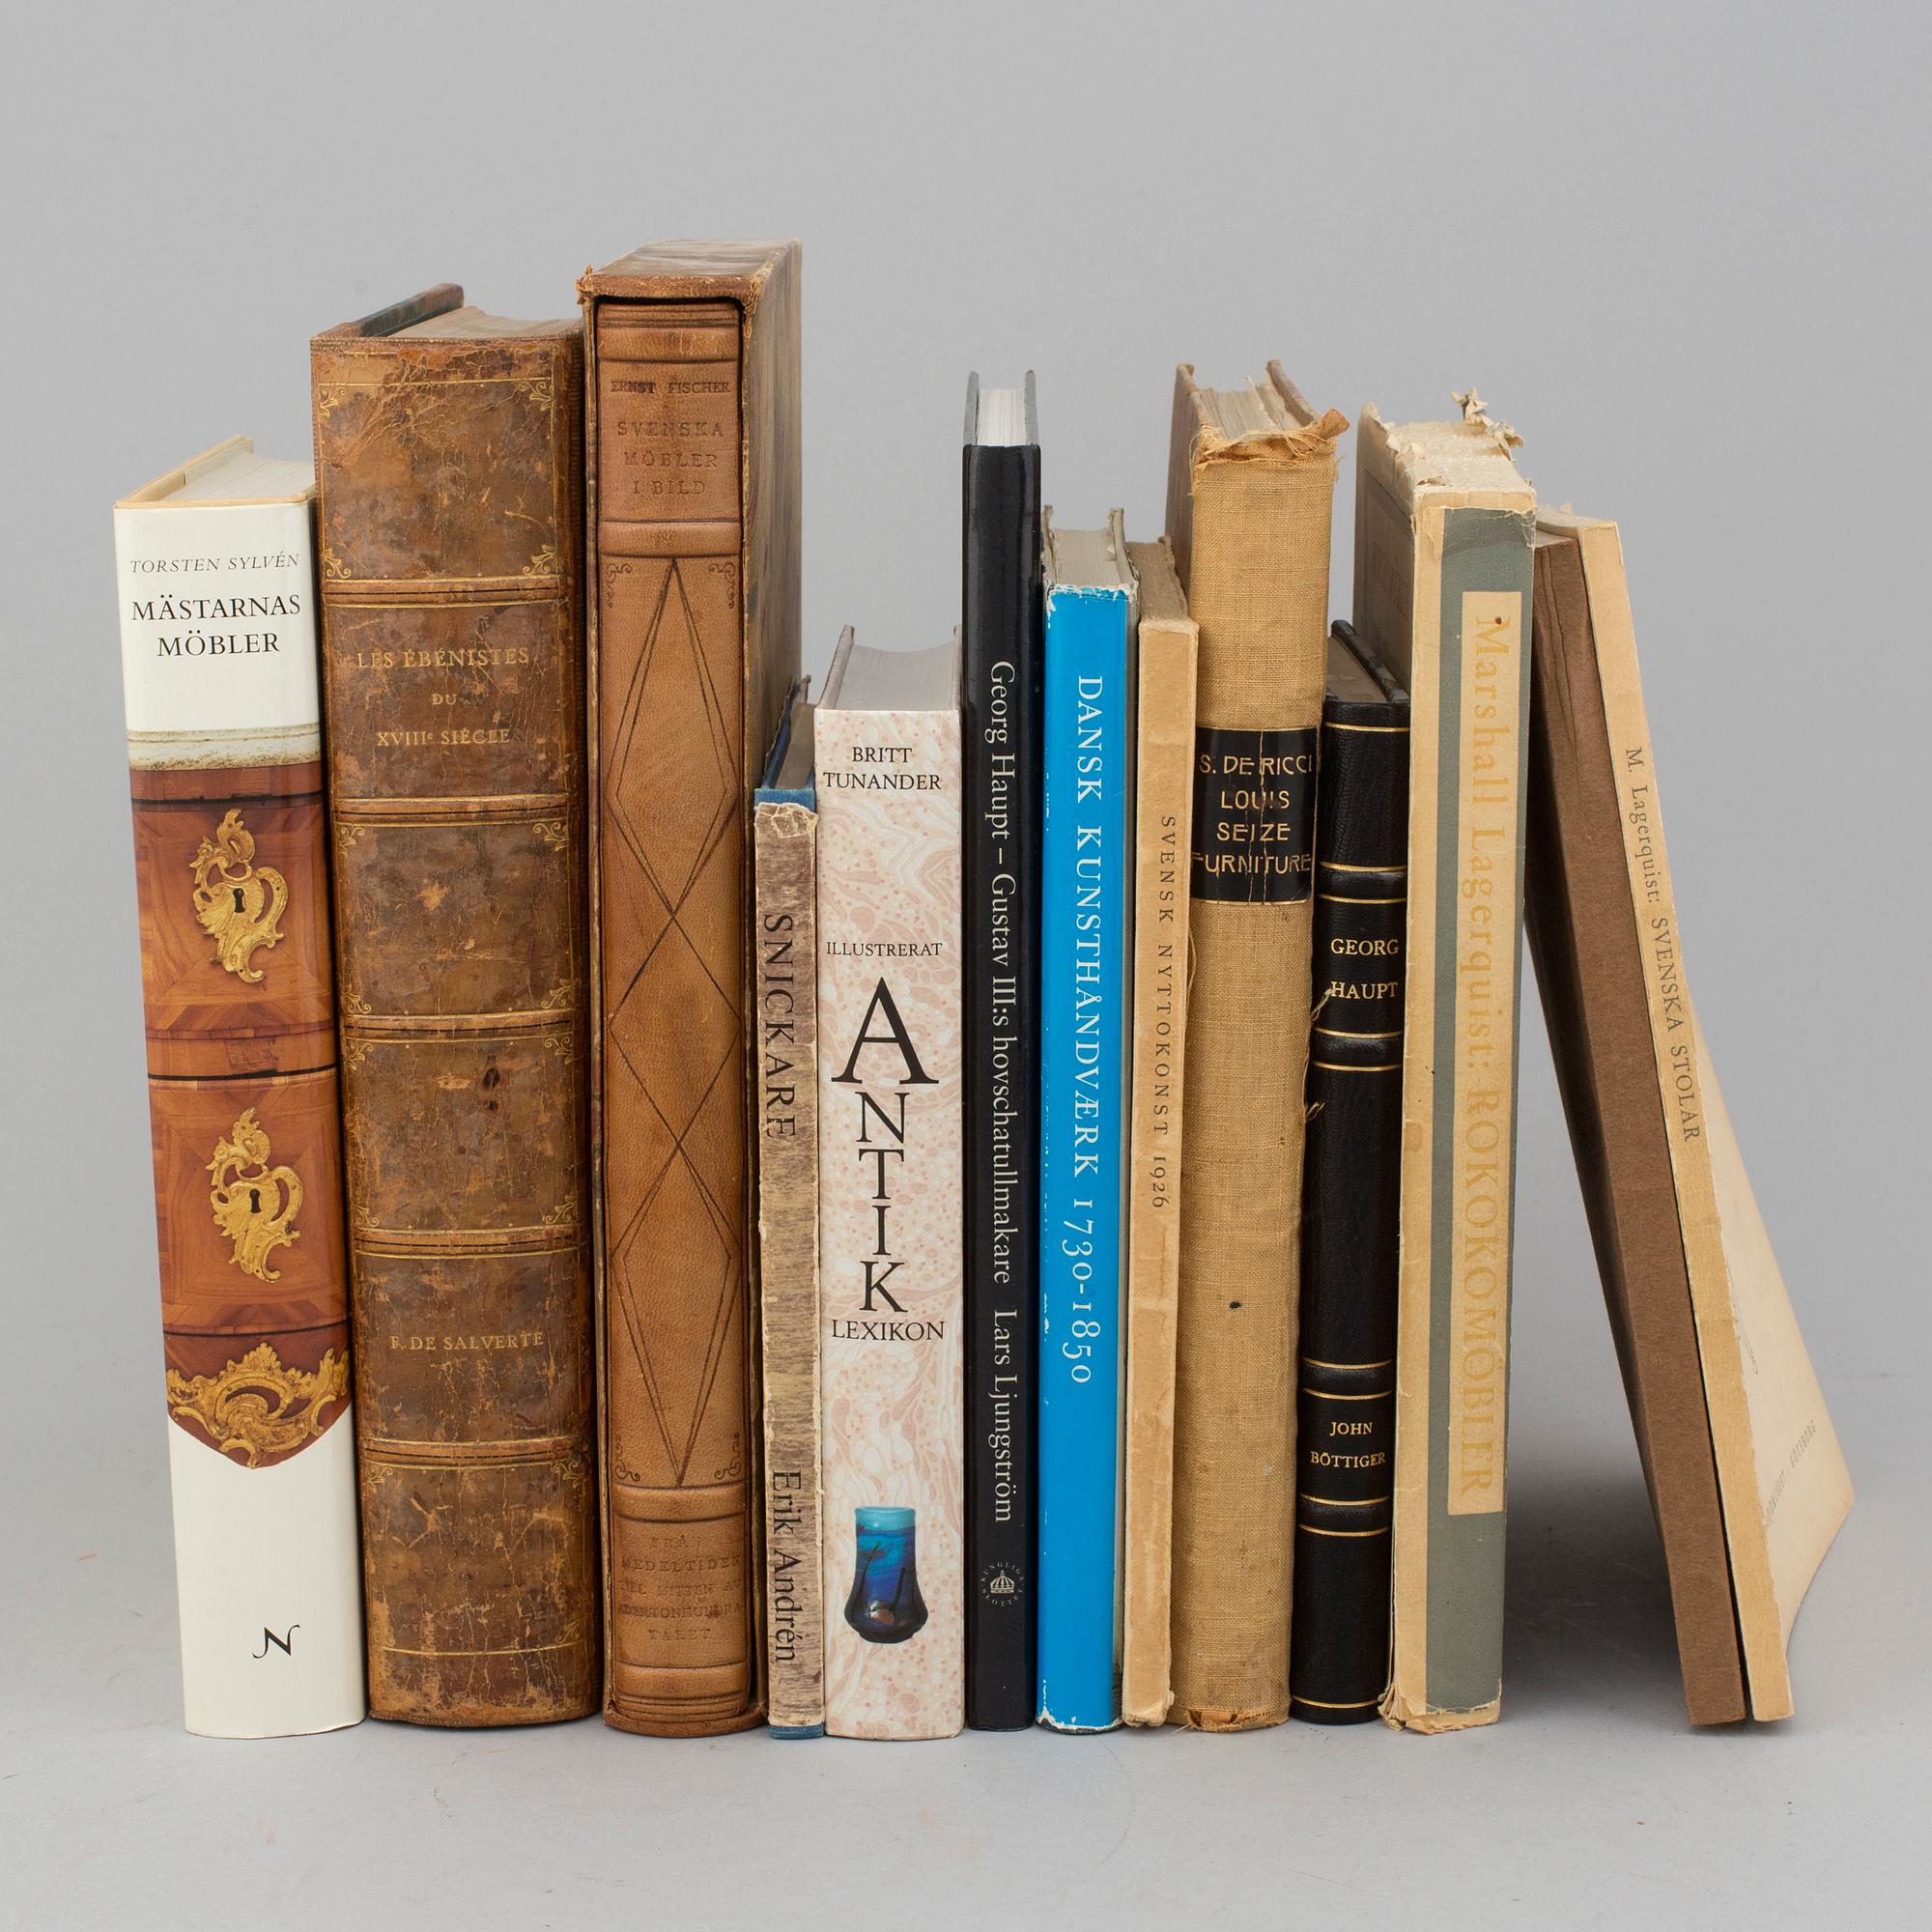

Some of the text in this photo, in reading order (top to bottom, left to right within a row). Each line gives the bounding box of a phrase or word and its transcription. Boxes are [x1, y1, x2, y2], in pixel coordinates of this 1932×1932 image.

[611, 381, 731, 394] ERNST FISCHER
[617, 421, 724, 437] SVENSKA
[624, 450, 718, 468] MÖBLER
[633, 480, 705, 495] I BILD
[130, 550, 299, 574] TORSTEN SYLVÉN
[131, 593, 301, 621] MÄSTARNAS
[156, 630, 280, 657] MÖBLER
[357, 647, 530, 668] LES ÉBÉNISTES
[431, 694, 457, 705] DU
[984, 661, 1015, 744] Georg
[440, 727, 511, 745] SIÈCLE
[852, 747, 913, 763] BRITT
[1199, 753, 1313, 776] S. DE RICCI
[823, 772, 942, 790] TUNANDER
[984, 753, 1016, 839] Haupt
[1221, 790, 1290, 810] LOUIS
[1216, 822, 1292, 841] SEIZE
[991, 873, 1016, 967] Gustav
[826, 942, 943, 957] ILLUSTRERAT
[1330, 938, 1400, 955] GEORG
[1625, 747, 1700, 1142] M. Lagerquist: SVENSKA STOLAR
[1330, 980, 1398, 999] HAUPT
[992, 976, 1017, 1027] III:s
[1150, 815, 1176, 1208] SVENSK NYTTOKONST 1926
[763, 913, 795, 1138] SNICKARE
[1062, 675, 1103, 1384] DANSK KUNSTHÅNDVÆRK 1730-1850
[1460, 616, 1511, 1495] Marshall Lagerquist: ROKOKOMÖBLER
[831, 977, 940, 1313] ANTIK
[992, 1036, 1019, 1284] hovschatullmakare
[410, 1335, 436, 1350] DE
[443, 1332, 544, 1350] SALVERTE
[832, 1321, 945, 1341] LEXIKON
[994, 1309, 1018, 1365] Lars
[1329, 1421, 1373, 1436] JOHN
[988, 1375, 1018, 1523] Ljungström
[1310, 1451, 1386, 1468] BÖTTIGER
[772, 1469, 804, 1662] Erik Andrén
